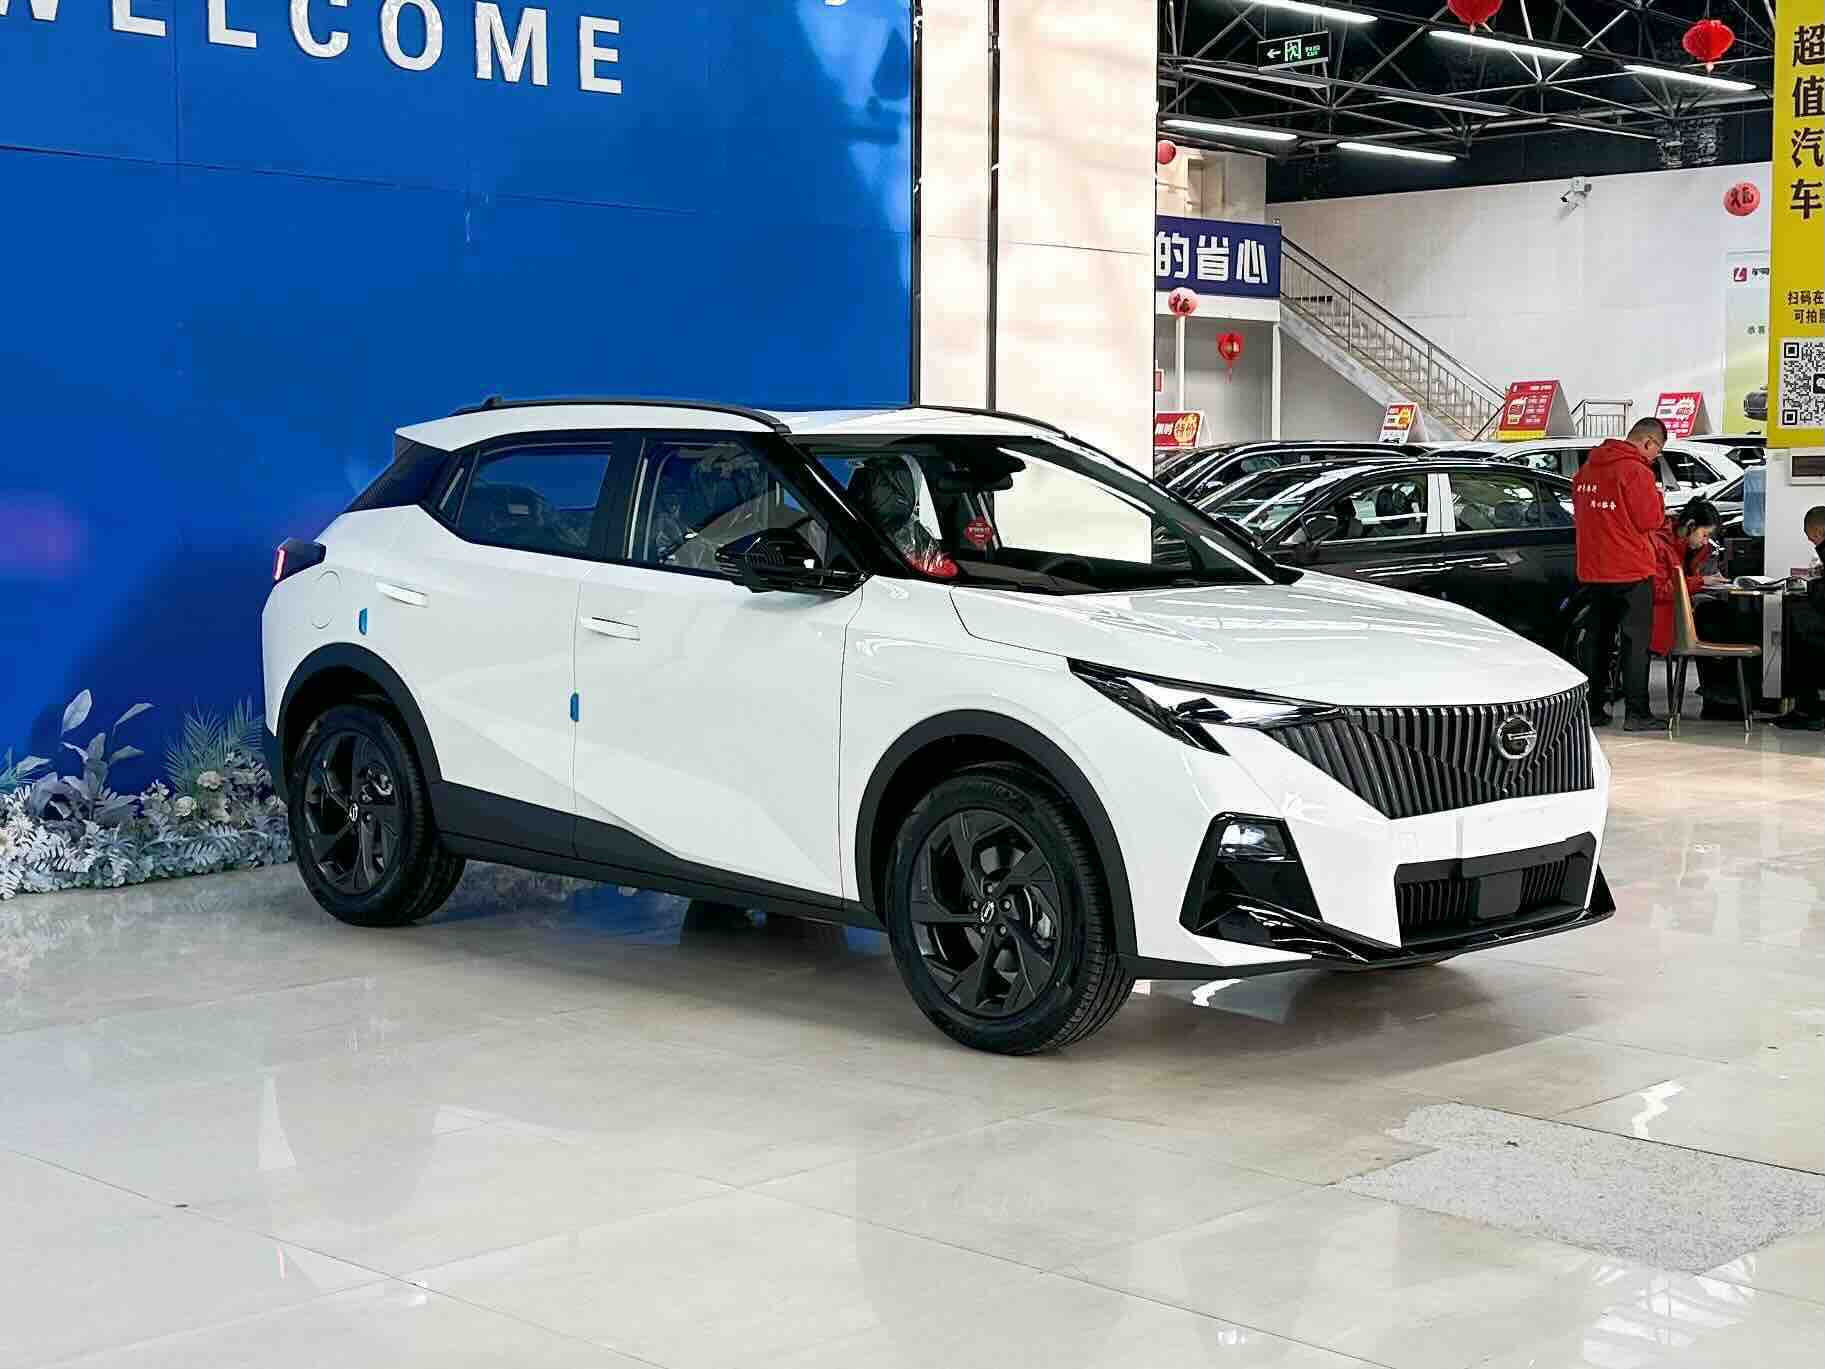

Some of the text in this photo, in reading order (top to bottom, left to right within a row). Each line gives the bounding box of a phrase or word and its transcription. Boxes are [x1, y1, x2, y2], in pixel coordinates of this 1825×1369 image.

[0, 0, 623, 94] LCOME
[1790, 24, 1825, 220] 超值汽车
[1156, 231, 1268, 284] 的省心
[1787, 290, 1824, 306] 扫码在
